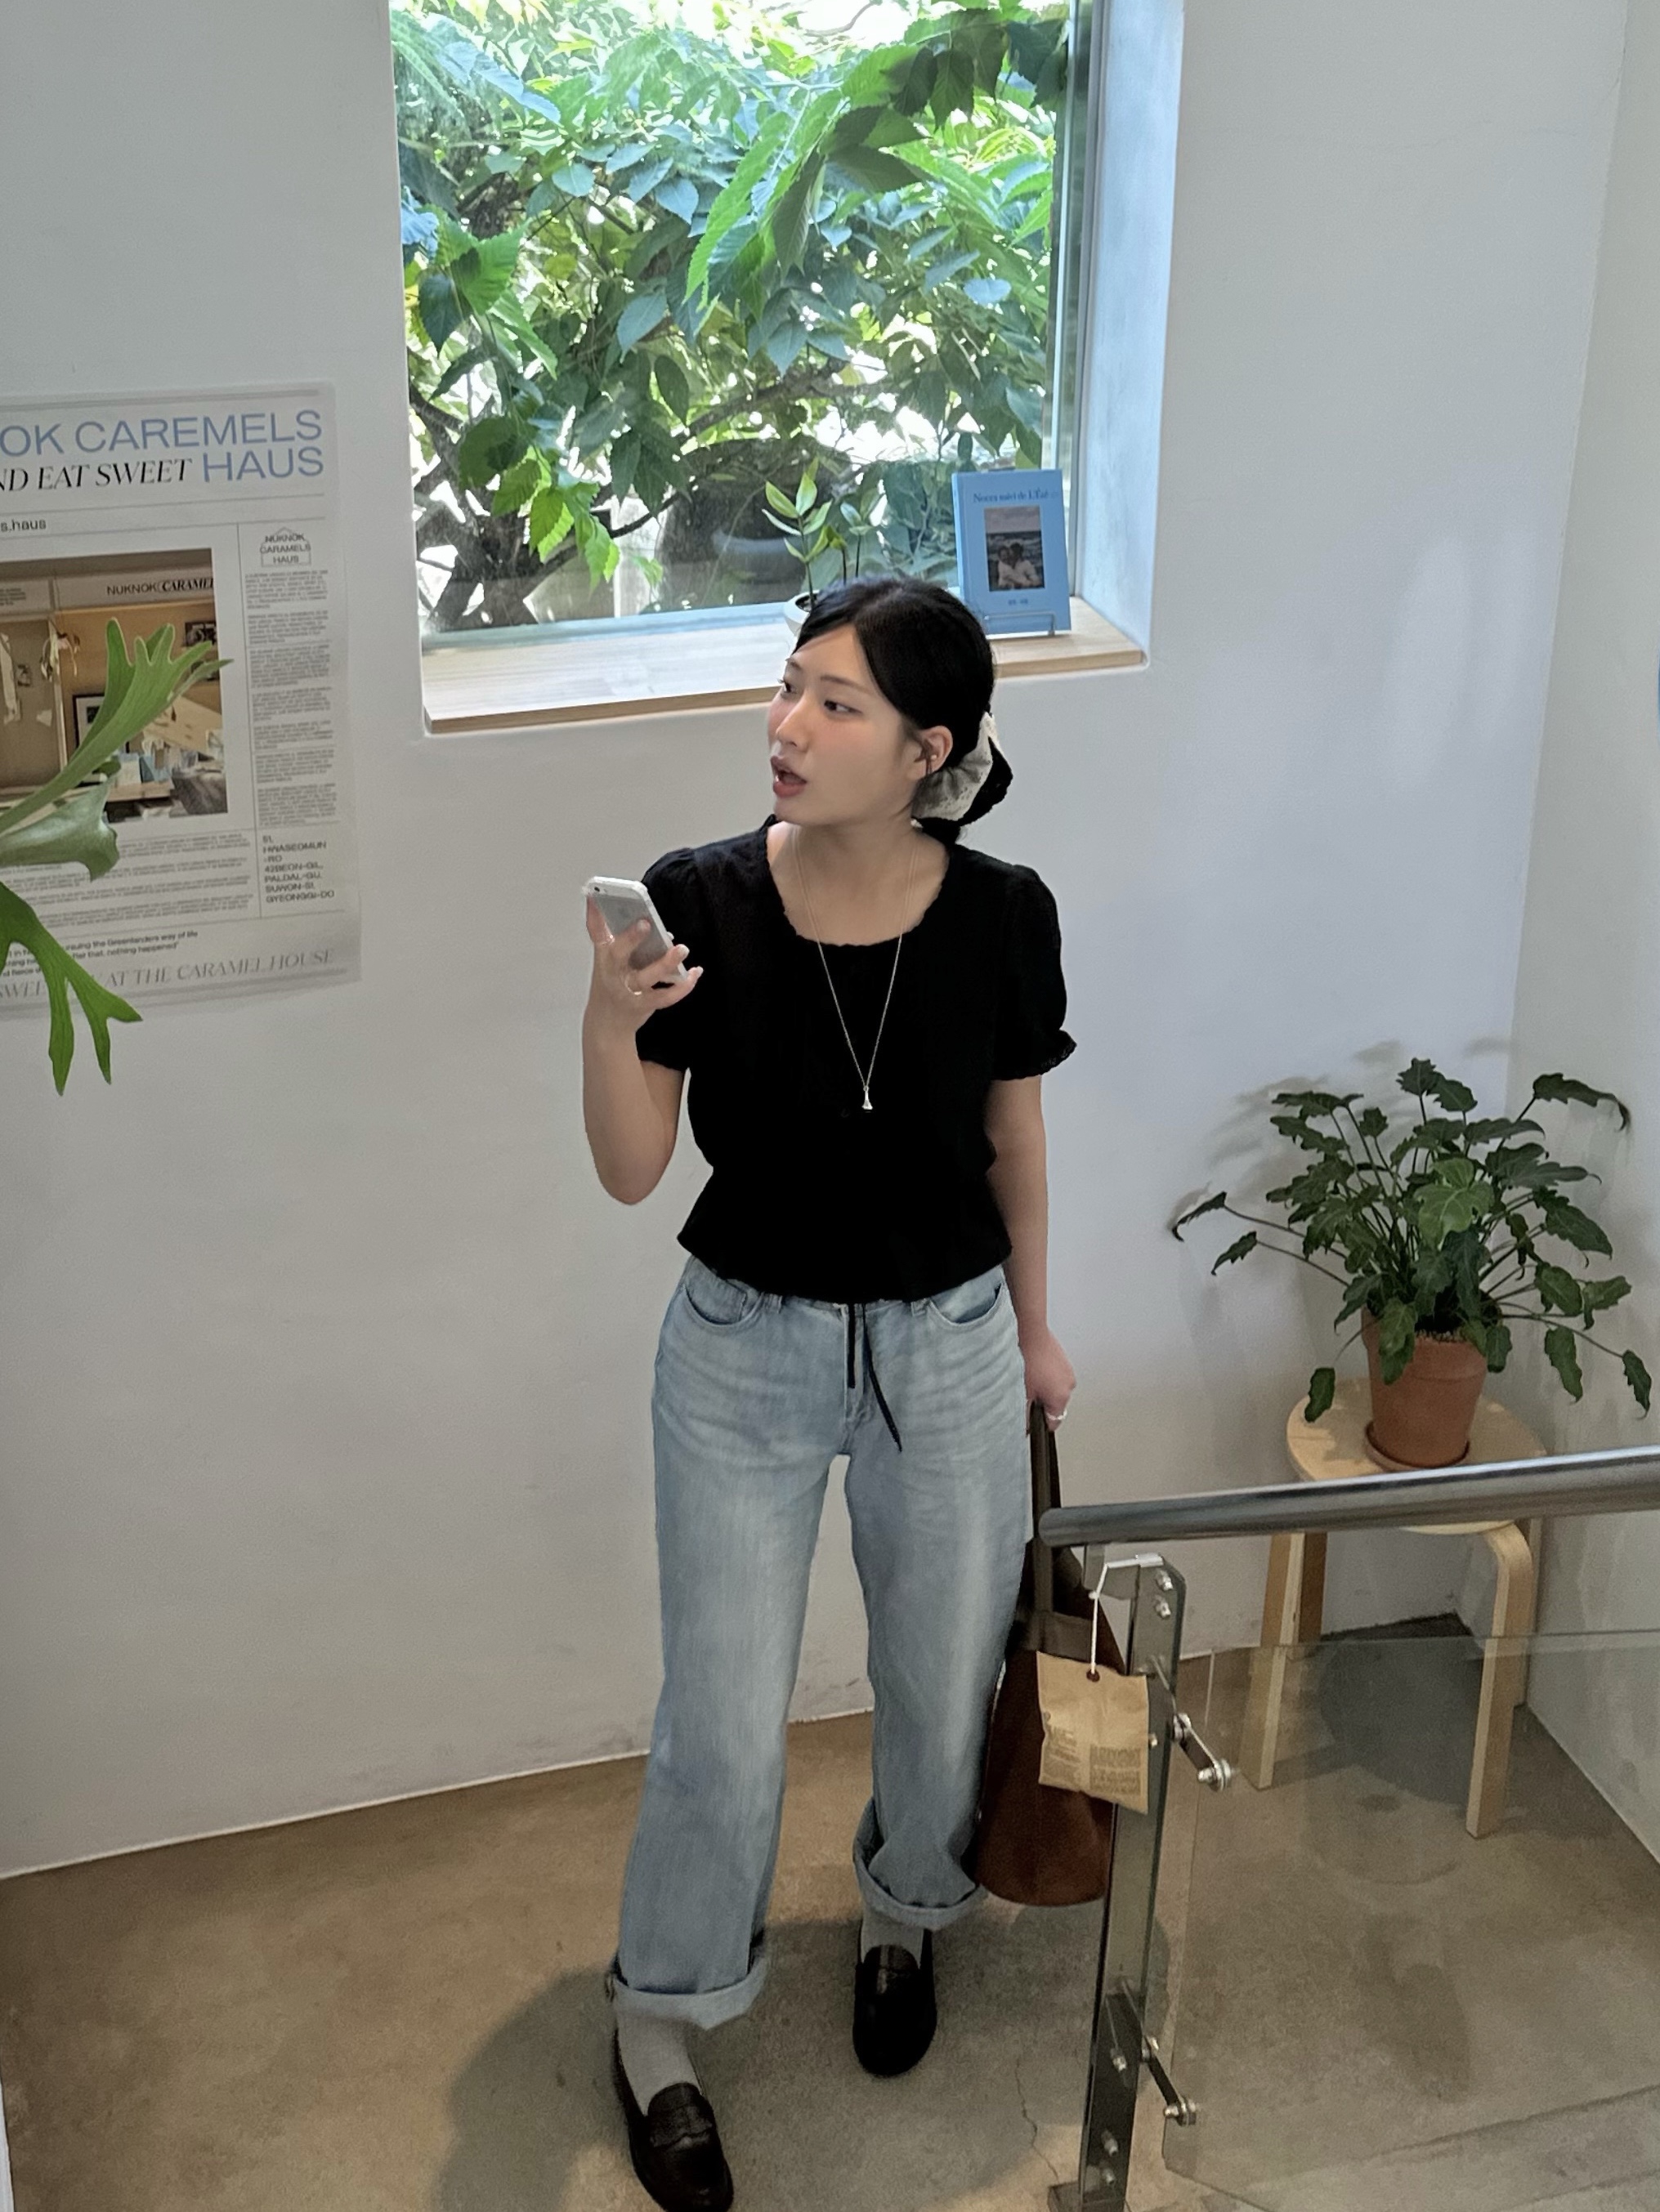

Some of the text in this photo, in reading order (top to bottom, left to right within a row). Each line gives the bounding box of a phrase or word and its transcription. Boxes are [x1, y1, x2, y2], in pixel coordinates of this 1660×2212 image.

[75, 410, 322, 454] CAREMELS
[38, 466, 90, 489] EAT
[96, 458, 193, 487] SWEET
[204, 446, 324, 482] HAUS
[265, 533, 305, 543] NUKNOK
[273, 556, 299, 564] HAUS
[107, 583, 156, 596] NUKNOK
[132, 966, 171, 985] THE
